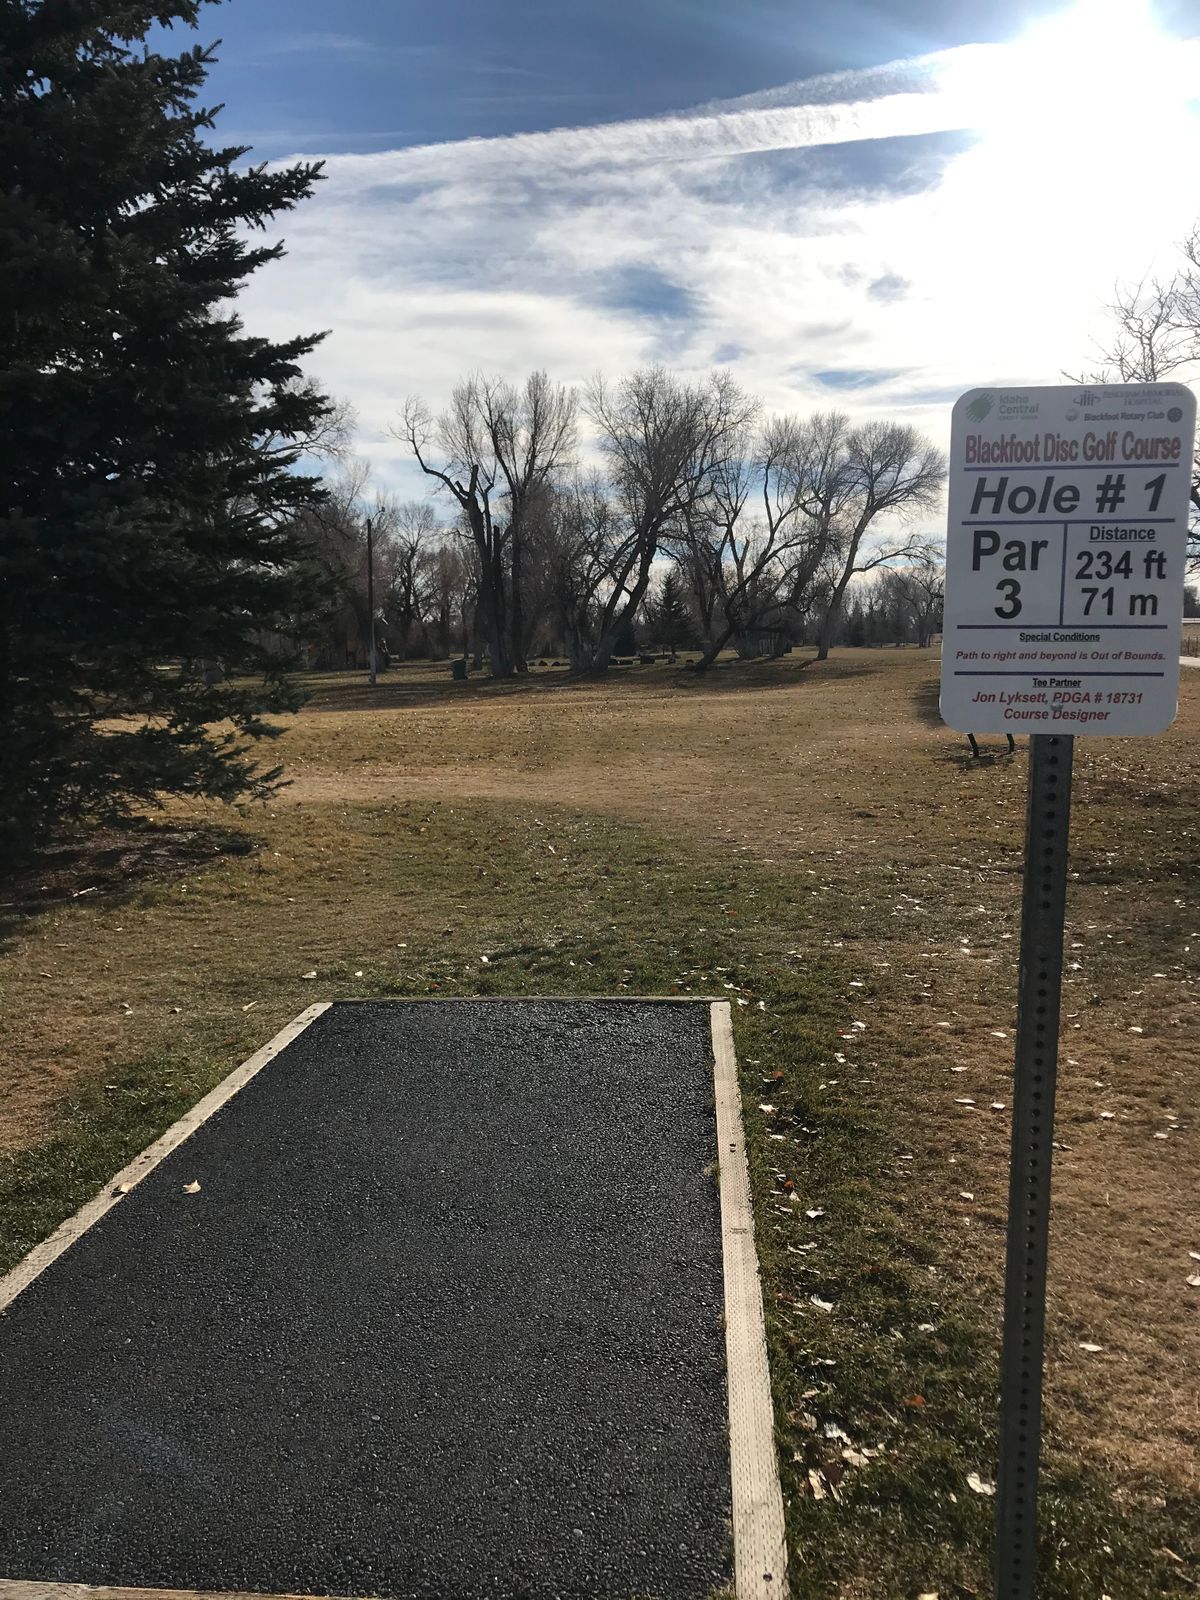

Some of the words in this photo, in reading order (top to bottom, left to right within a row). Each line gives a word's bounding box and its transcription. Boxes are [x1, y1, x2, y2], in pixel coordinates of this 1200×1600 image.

[999, 395, 1030, 404] Idaho
[999, 403, 1040, 414] Central
[1084, 412, 1120, 421] Blackfoot
[1121, 412, 1145, 421] Rotary
[1147, 411, 1165, 420] Club
[965, 434, 1041, 464] Blackfoot
[1044, 433, 1079, 462] Disc
[1083, 431, 1118, 462] Golf
[1121, 431, 1181, 461] Course
[969, 476, 1080, 515] Hole
[1096, 474, 1126, 513] #
[1144, 473, 1167, 512] 1
[1089, 526, 1156, 541] Distance
[972, 530, 1048, 571] Par
[1075, 550, 1133, 580] 234
[1143, 550, 1167, 580] ft
[994, 578, 1022, 619] 3
[1081, 587, 1115, 616] 71
[1129, 593, 1158, 616] m
[1019, 632, 1050, 642] Special
[1053, 632, 1100, 642] Conditions
[956, 651, 978, 660] Path
[980, 652, 991, 660] to
[993, 651, 1016, 661] right
[1018, 651, 1037, 660] and
[1040, 651, 1077, 662] beyond
[1079, 651, 1087, 660] is
[1091, 652, 1109, 660] Out
[1111, 651, 1123, 660] of
[1124, 652, 1166, 661] Bounds.
[1032, 679, 1047, 687] Tee
[1050, 679, 1081, 688] Partner
[972, 692, 996, 703] Jon
[999, 692, 1048, 705] Lyksett,
[1053, 692, 1091, 704] PDGA
[1094, 692, 1103, 703] #
[1106, 693, 1143, 704] 18731
[1004, 708, 1049, 720] Course
[1053, 709, 1111, 722] Designer
